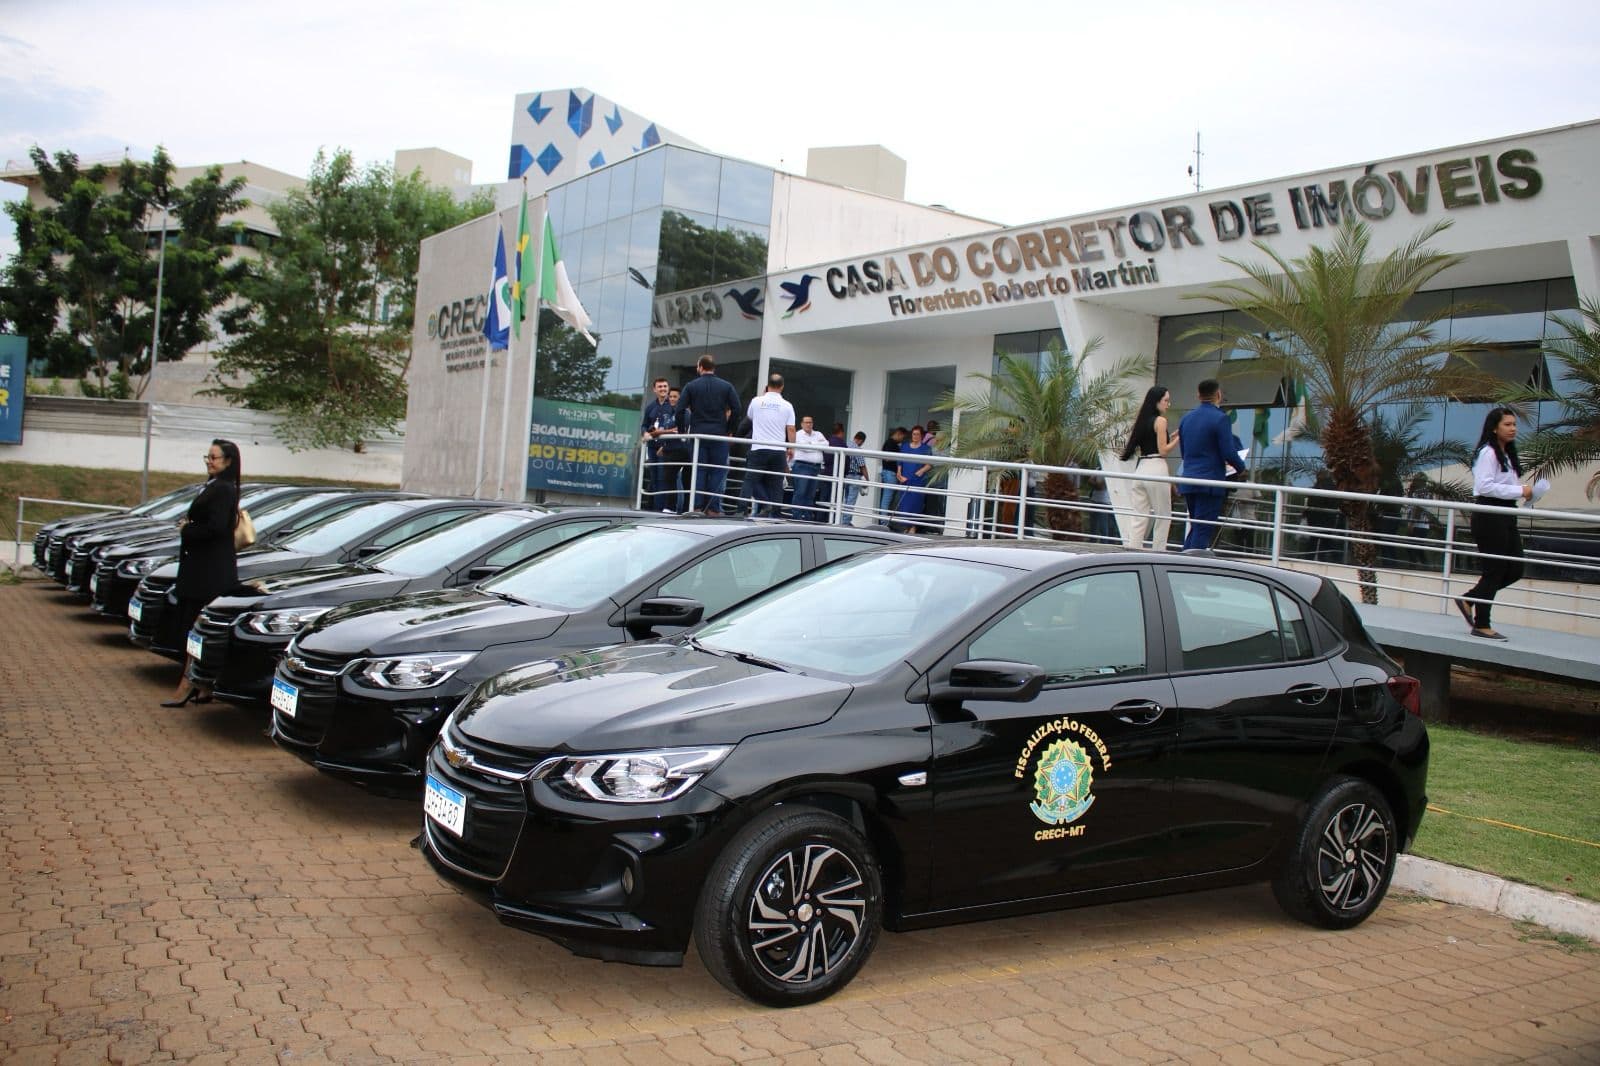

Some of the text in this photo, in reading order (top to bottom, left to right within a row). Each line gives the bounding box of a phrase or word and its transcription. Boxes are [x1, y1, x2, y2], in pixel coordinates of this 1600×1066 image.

[826, 148, 1544, 300] CASA DO CORRETOR DE IMÓVEIS
[888, 258, 1160, 316] Florentino Roberto Martini
[438, 293, 489, 340] CREC
[1015, 717, 1112, 779] FISCALIZAÇÃO FEDERAL
[1034, 825, 1086, 841] CRECI-MT
